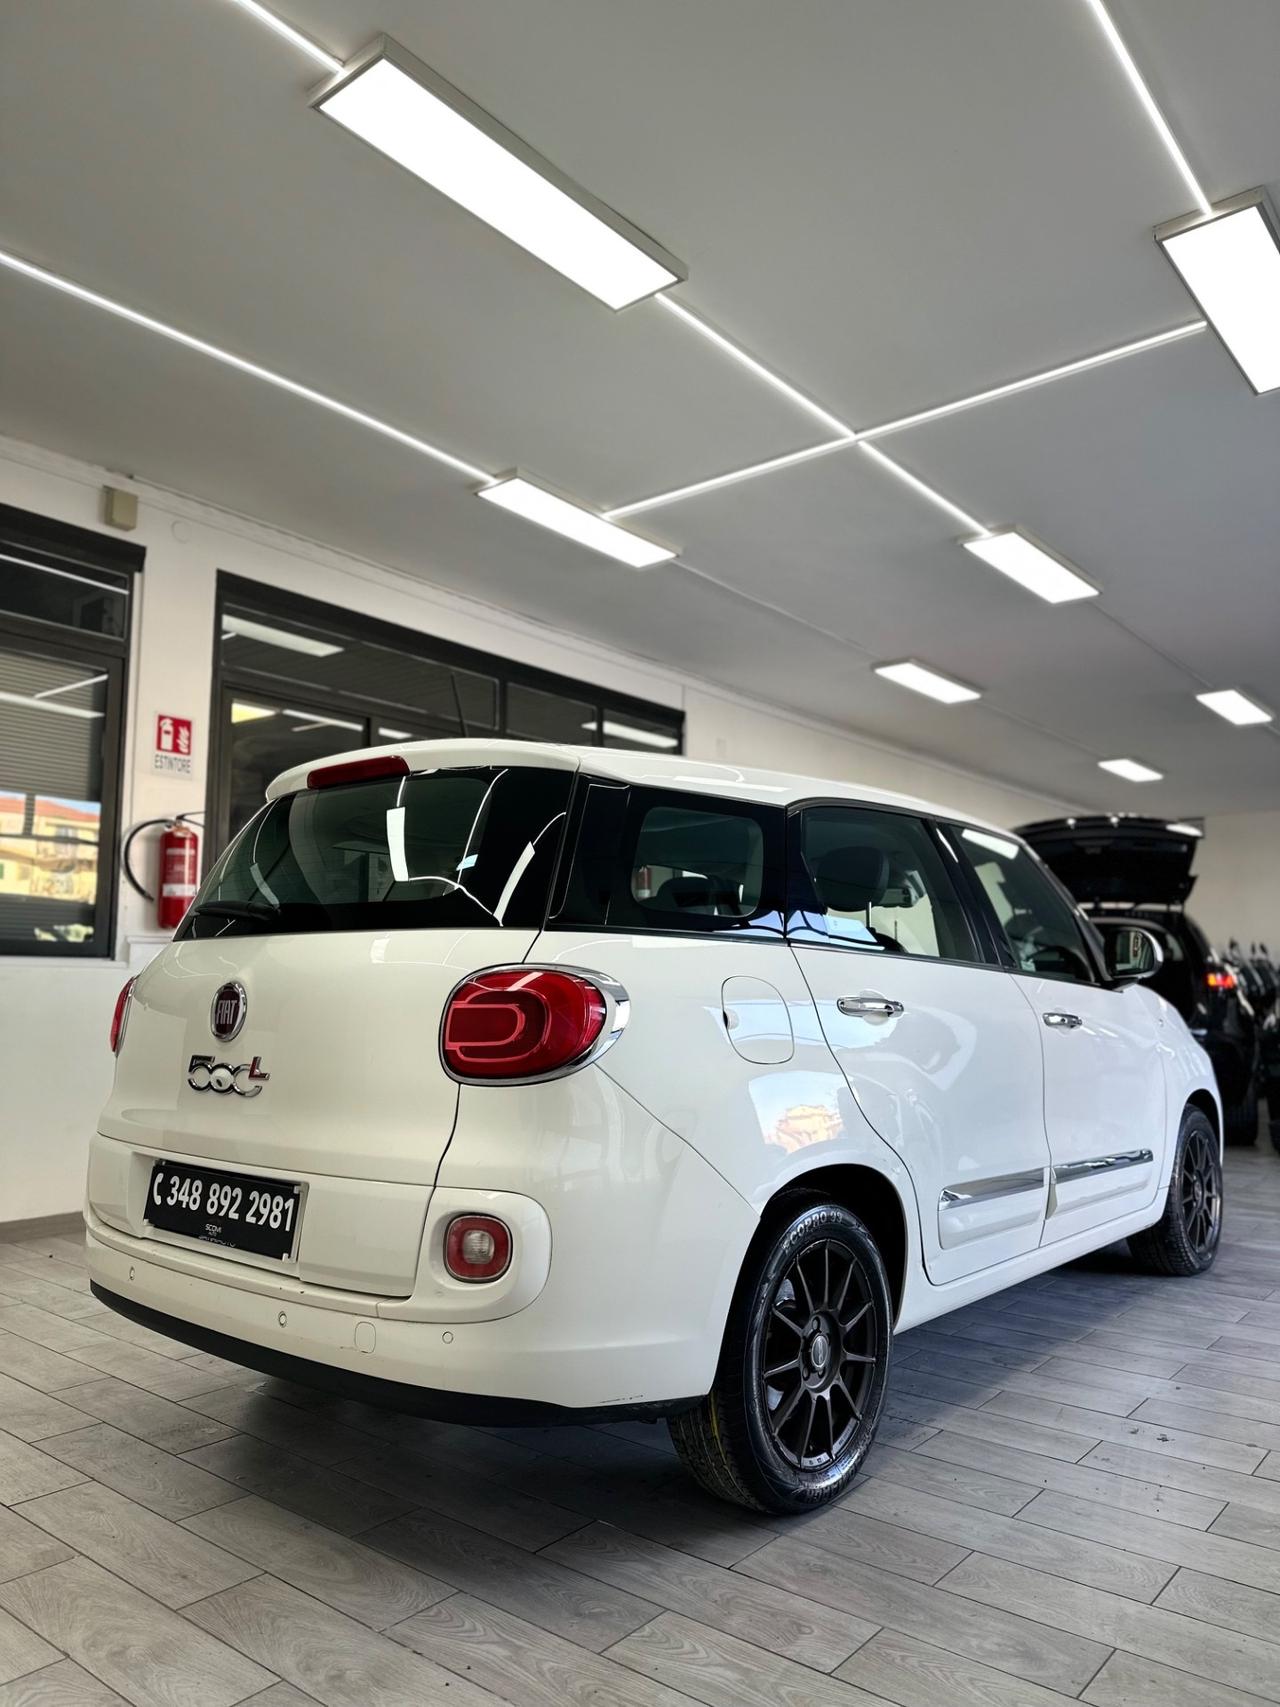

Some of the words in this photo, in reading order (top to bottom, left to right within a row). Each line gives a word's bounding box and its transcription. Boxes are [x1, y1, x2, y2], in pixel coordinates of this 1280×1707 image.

[154, 753, 191, 774] ESTINTORE
[215, 999, 238, 1025] FIAT
[166, 1175, 203, 1211] 348
[206, 1183, 242, 1220] 892
[245, 1190, 295, 1232] 2981
